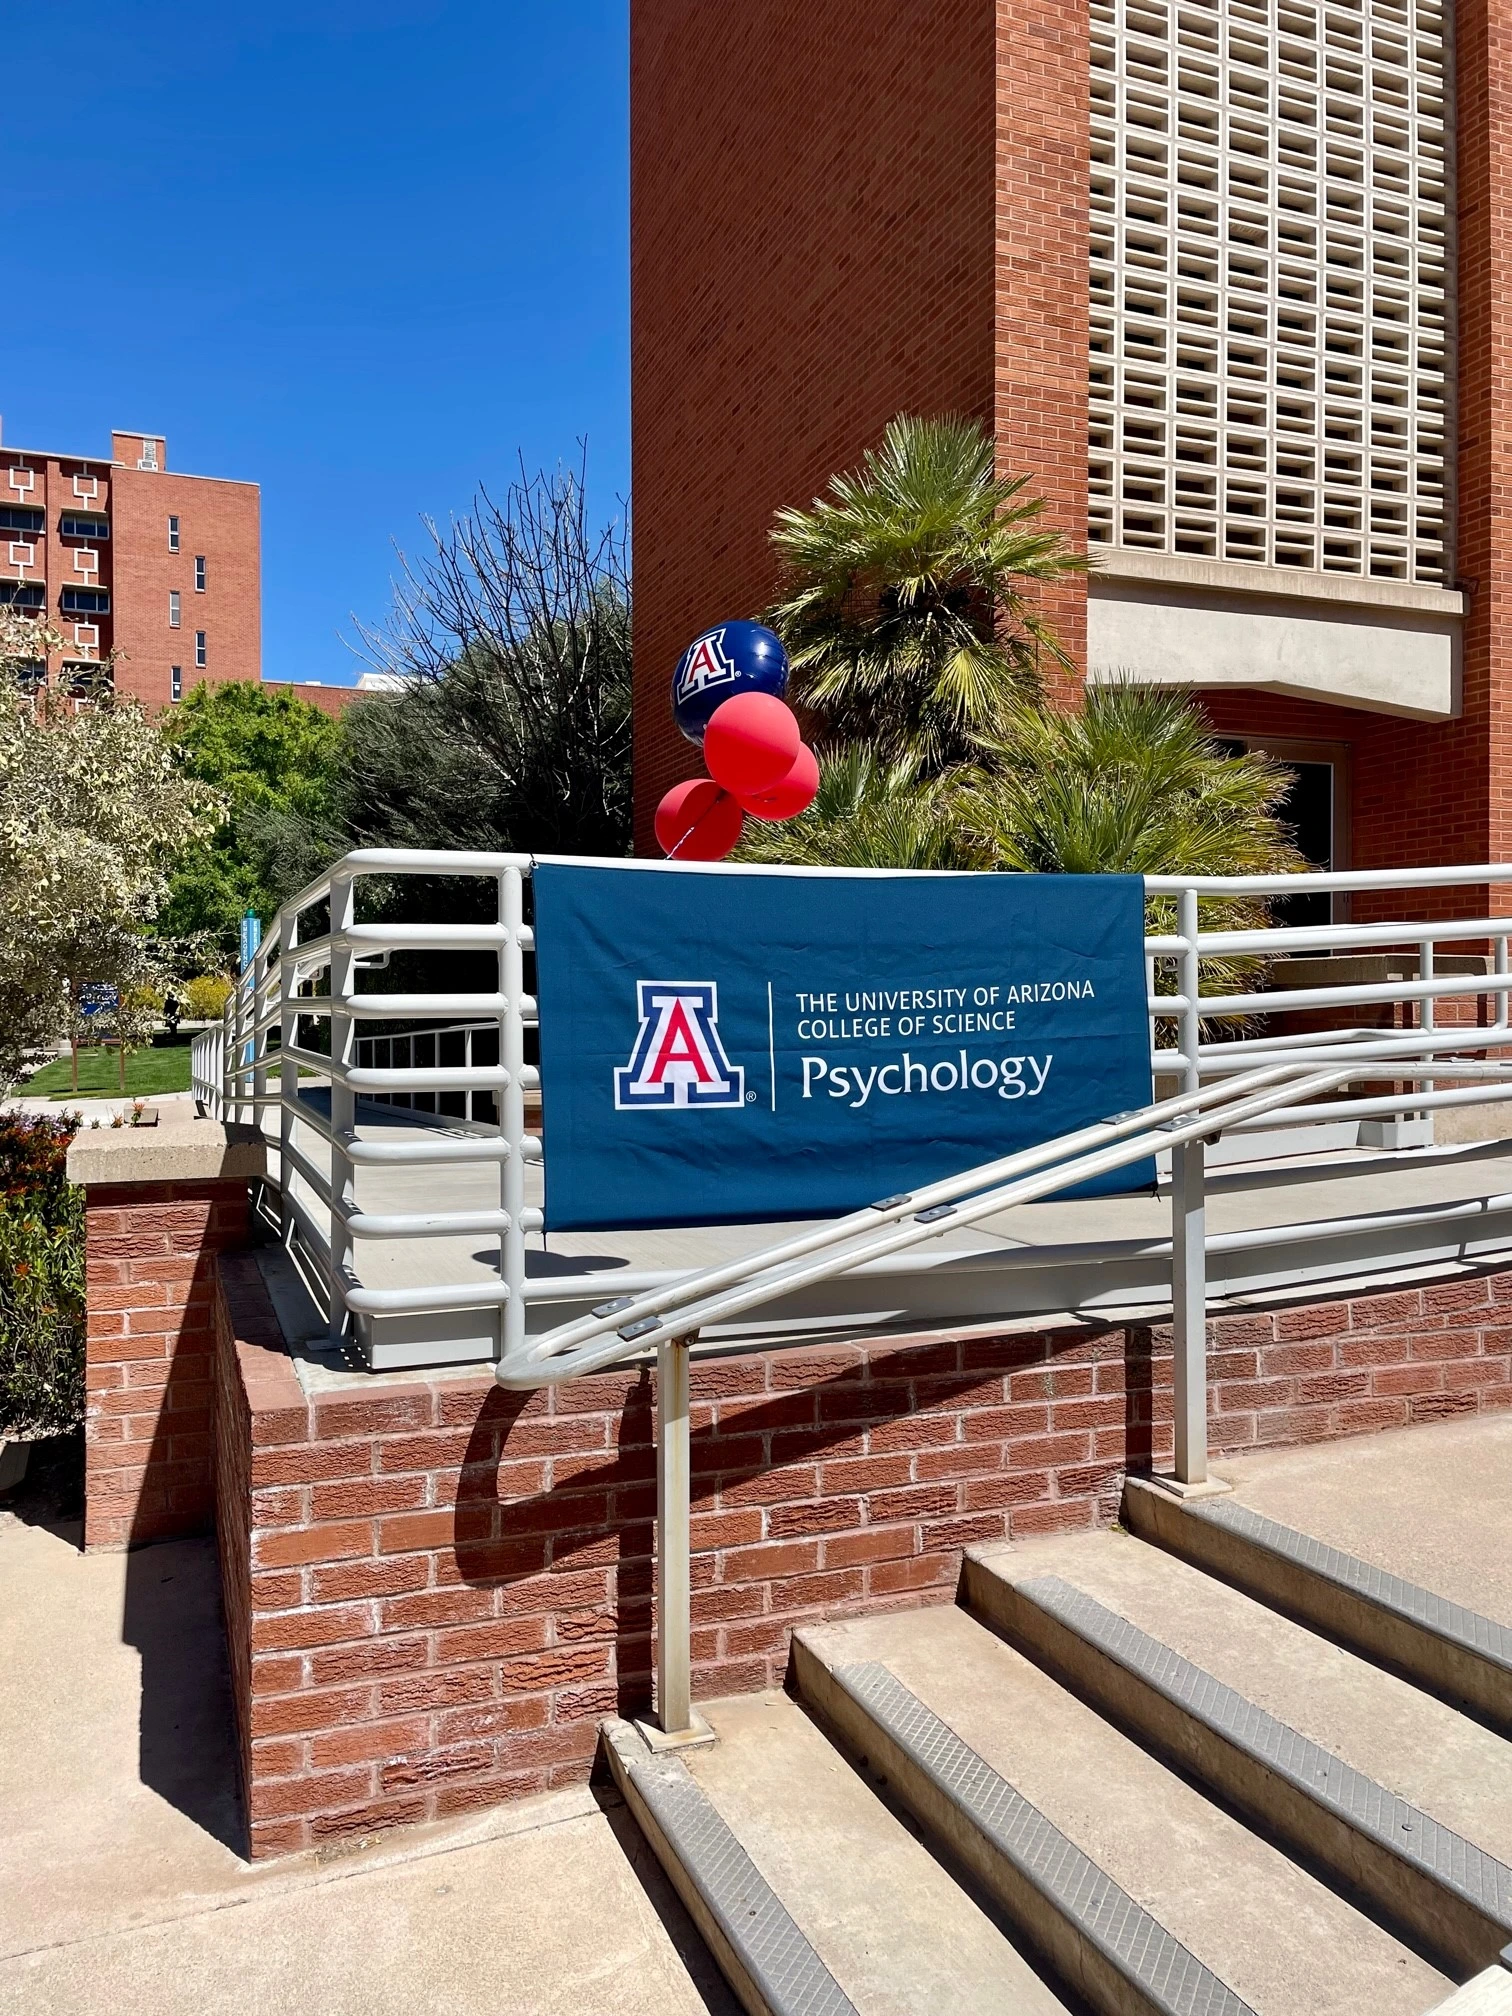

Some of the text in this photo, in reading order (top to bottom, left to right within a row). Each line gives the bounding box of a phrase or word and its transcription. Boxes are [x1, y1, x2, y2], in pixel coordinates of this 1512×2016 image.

[677, 628, 735, 705] A
[796, 980, 1095, 1012] THE UNIVERSITY OF ARIZONA
[797, 1011, 1016, 1039] COLLEGE OF SCIENCE
[614, 980, 744, 1110] A
[801, 1049, 1053, 1108] Psychology
